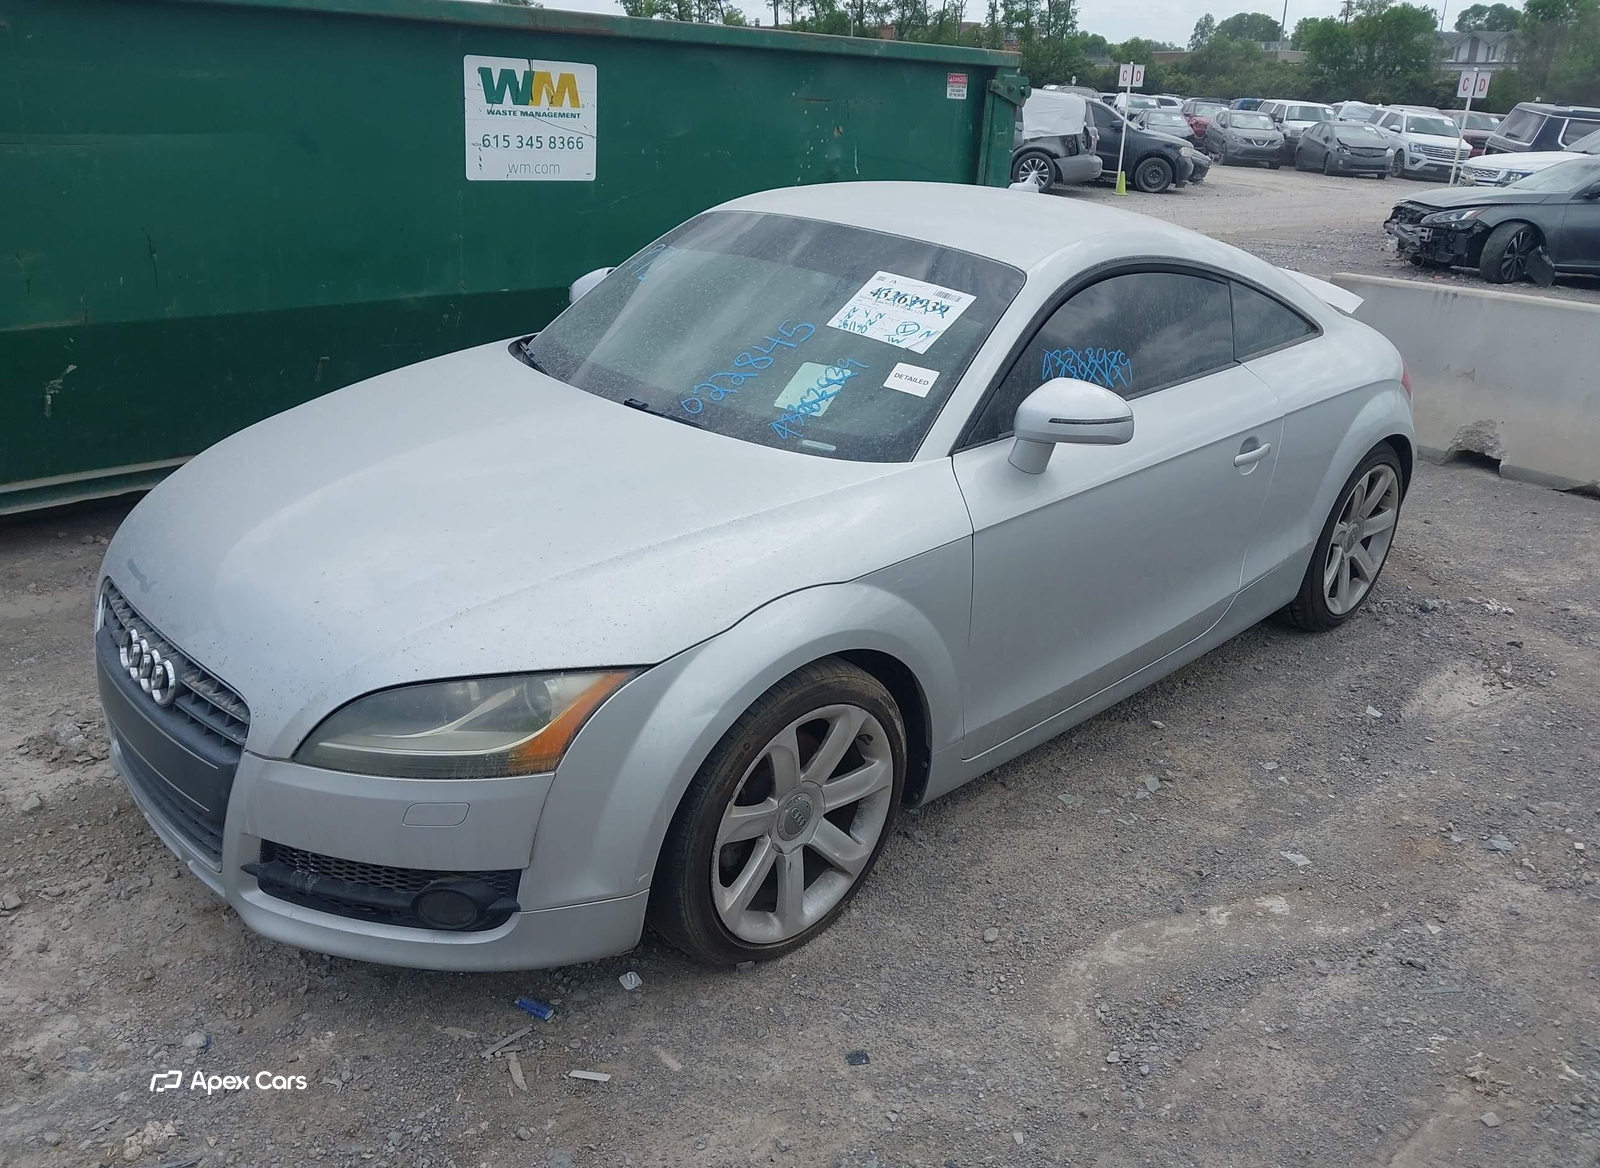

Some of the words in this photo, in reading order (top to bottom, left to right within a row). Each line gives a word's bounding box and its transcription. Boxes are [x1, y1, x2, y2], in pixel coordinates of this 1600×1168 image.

[1122, 69, 1128, 81] C
[1135, 70, 1142, 81] D
[478, 66, 581, 108] WM
[1463, 77, 1469, 91] C
[1479, 78, 1486, 92] D
[486, 108, 518, 117] WASTE
[519, 110, 581, 119] MANAGEMENT
[482, 133, 511, 149] 615
[516, 134, 543, 150] 345
[548, 136, 584, 150] 8366
[507, 163, 560, 174] wm.com
[893, 372, 930, 387] DETAILED
